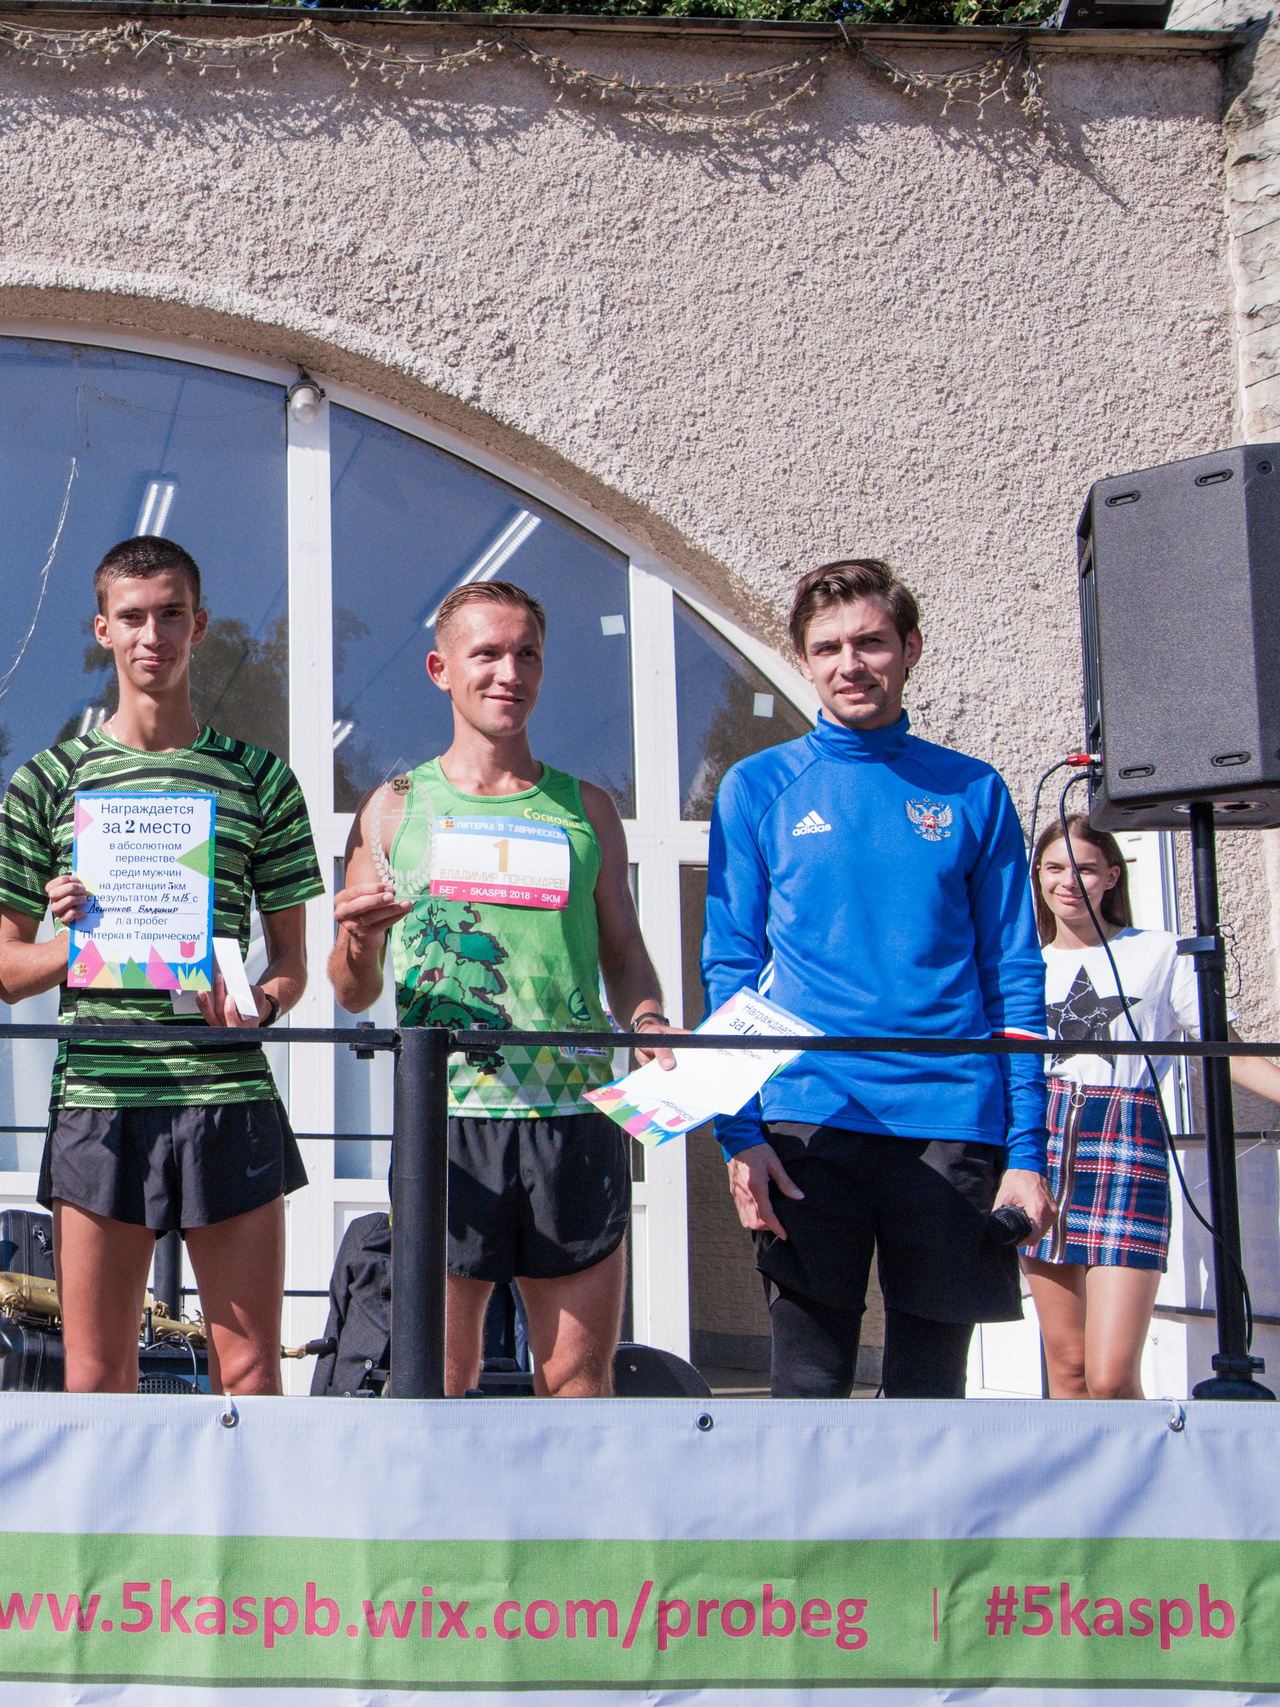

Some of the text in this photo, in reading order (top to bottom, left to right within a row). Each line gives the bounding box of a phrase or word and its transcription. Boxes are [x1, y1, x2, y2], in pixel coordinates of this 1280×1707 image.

[101, 803, 193, 816] Награждается
[102, 819, 191, 834] за 2 место
[457, 822, 566, 840] ПЯТЕРКА В ТАВРИЧЕСКОМ
[792, 823, 831, 837] adidas
[117, 841, 182, 850] абсолютном
[116, 855, 175, 864] первенстве
[493, 839, 509, 872] 1
[110, 869, 181, 879] среди мужчин
[440, 869, 566, 889] ВЛАДИМИР ПОНОМАРЕВ
[113, 883, 166, 891] дистанции
[439, 886, 458, 894] БЕГ
[470, 887, 507, 897] 5KASPB
[509, 890, 530, 899] 2018
[95, 894, 157, 904] результатом
[134, 916, 167, 926] пробег
[729, 1018, 745, 1031] за
[743, 1003, 800, 1036] Награждаетс
[984, 1582, 1236, 1650] #5kaspb
